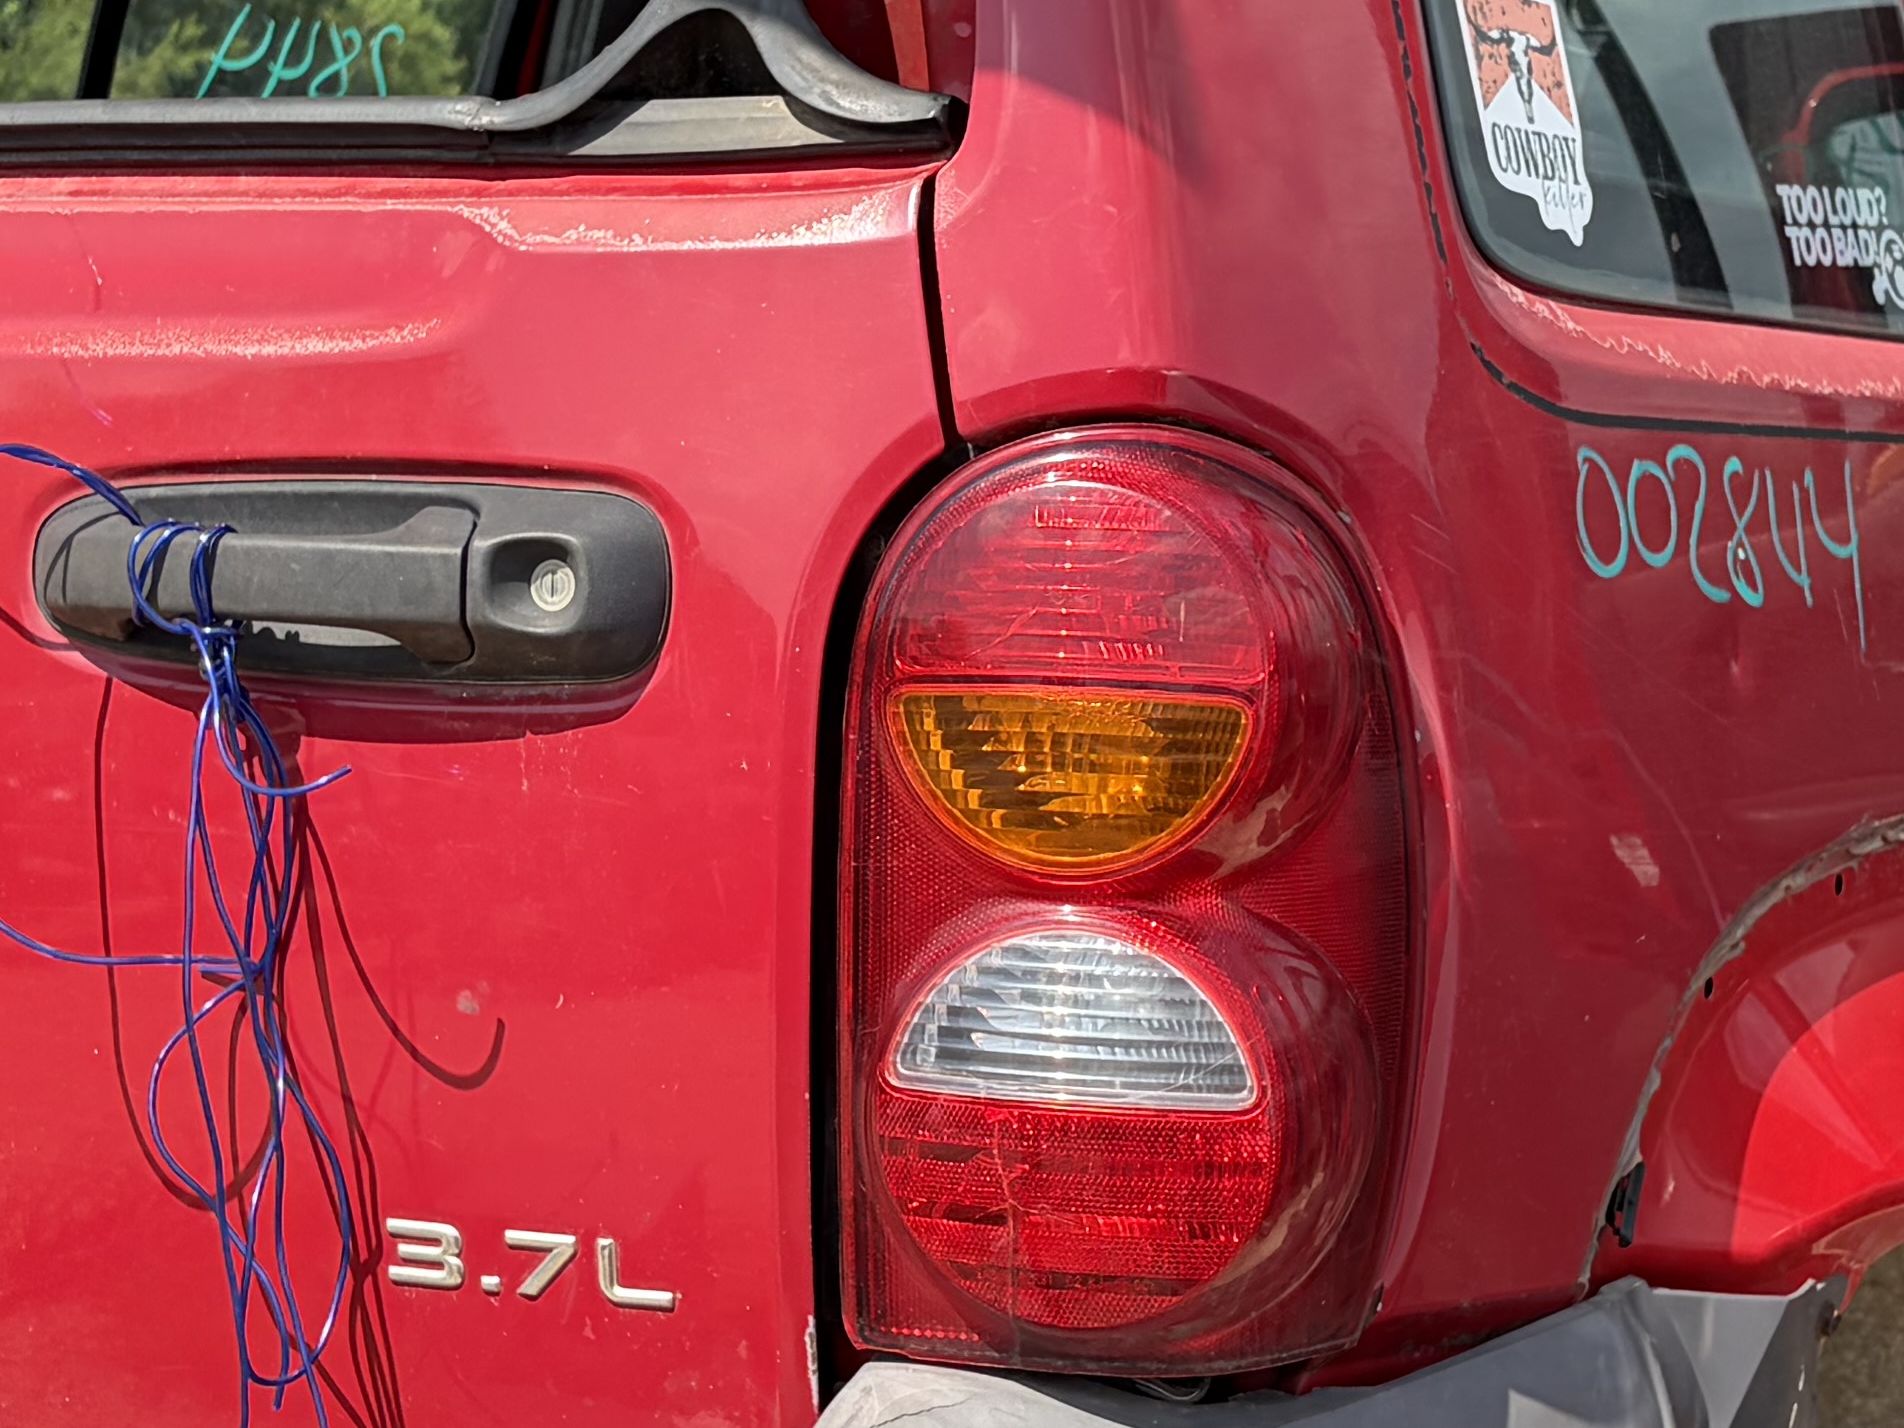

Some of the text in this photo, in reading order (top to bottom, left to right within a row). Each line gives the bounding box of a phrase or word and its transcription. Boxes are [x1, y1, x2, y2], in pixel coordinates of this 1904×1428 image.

[1491, 121, 1581, 187] COWBOY
[1776, 184, 1889, 226] TOO LOUD?
[1784, 226, 1881, 267] TOO BAD!
[1576, 444, 1867, 654] 002844
[386, 1217, 677, 1313] 3.7L
